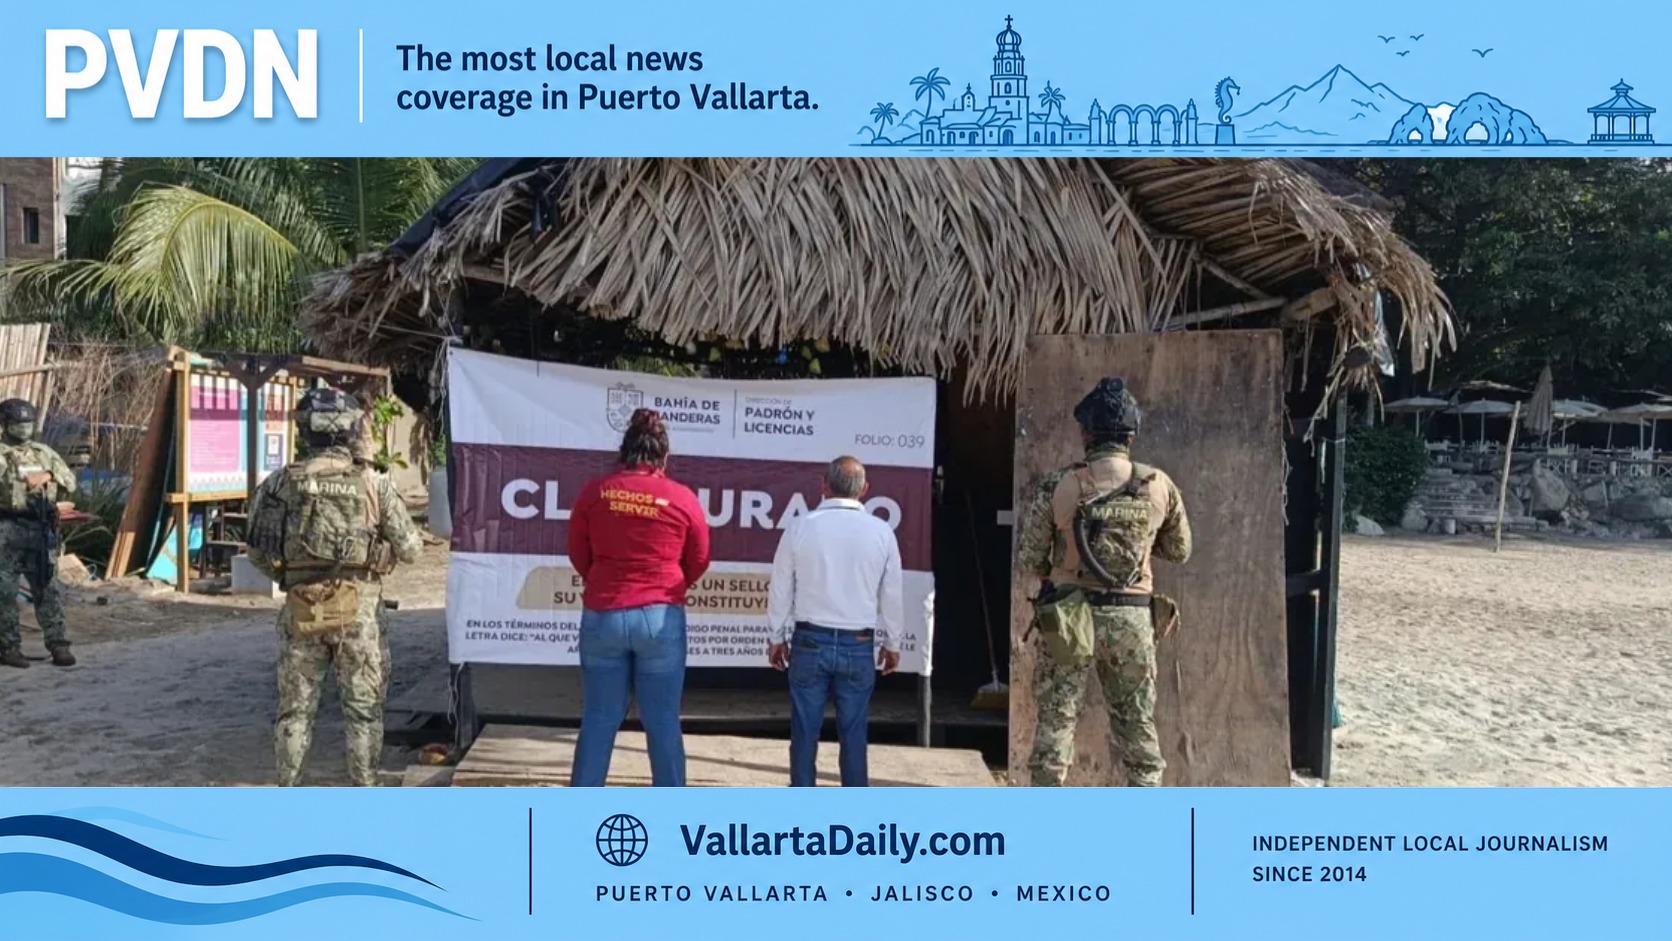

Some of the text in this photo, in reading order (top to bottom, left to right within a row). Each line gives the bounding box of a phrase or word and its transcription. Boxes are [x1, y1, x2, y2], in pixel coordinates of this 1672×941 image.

[654, 396, 720, 412] BAHÍA DE
[658, 411, 720, 425] ANDERAS
[745, 406, 815, 421] PADRÓN Y
[744, 423, 814, 436] LICENCIAS
[854, 434, 925, 448] FOLIO: 039
[297, 479, 357, 496] MARINA
[601, 489, 654, 504] HECHOS
[501, 478, 902, 530] CLURAO
[1091, 506, 1149, 519] MARINA
[702, 579, 725, 592] UN
[553, 591, 576, 605] SU
[685, 595, 769, 609] ONSTITUY
[466, 619, 481, 628] EN
[482, 621, 503, 629] LOS
[505, 618, 558, 631] TÉRMINOS
[685, 624, 709, 633] DIGO
[710, 624, 741, 634] PENAL
[465, 631, 498, 641] LETRA
[549, 634, 572, 644] QUE
[708, 635, 729, 645] POR
[730, 636, 764, 645] ORDEN
[711, 647, 735, 656] TRES
[736, 645, 763, 656] AÑOS
